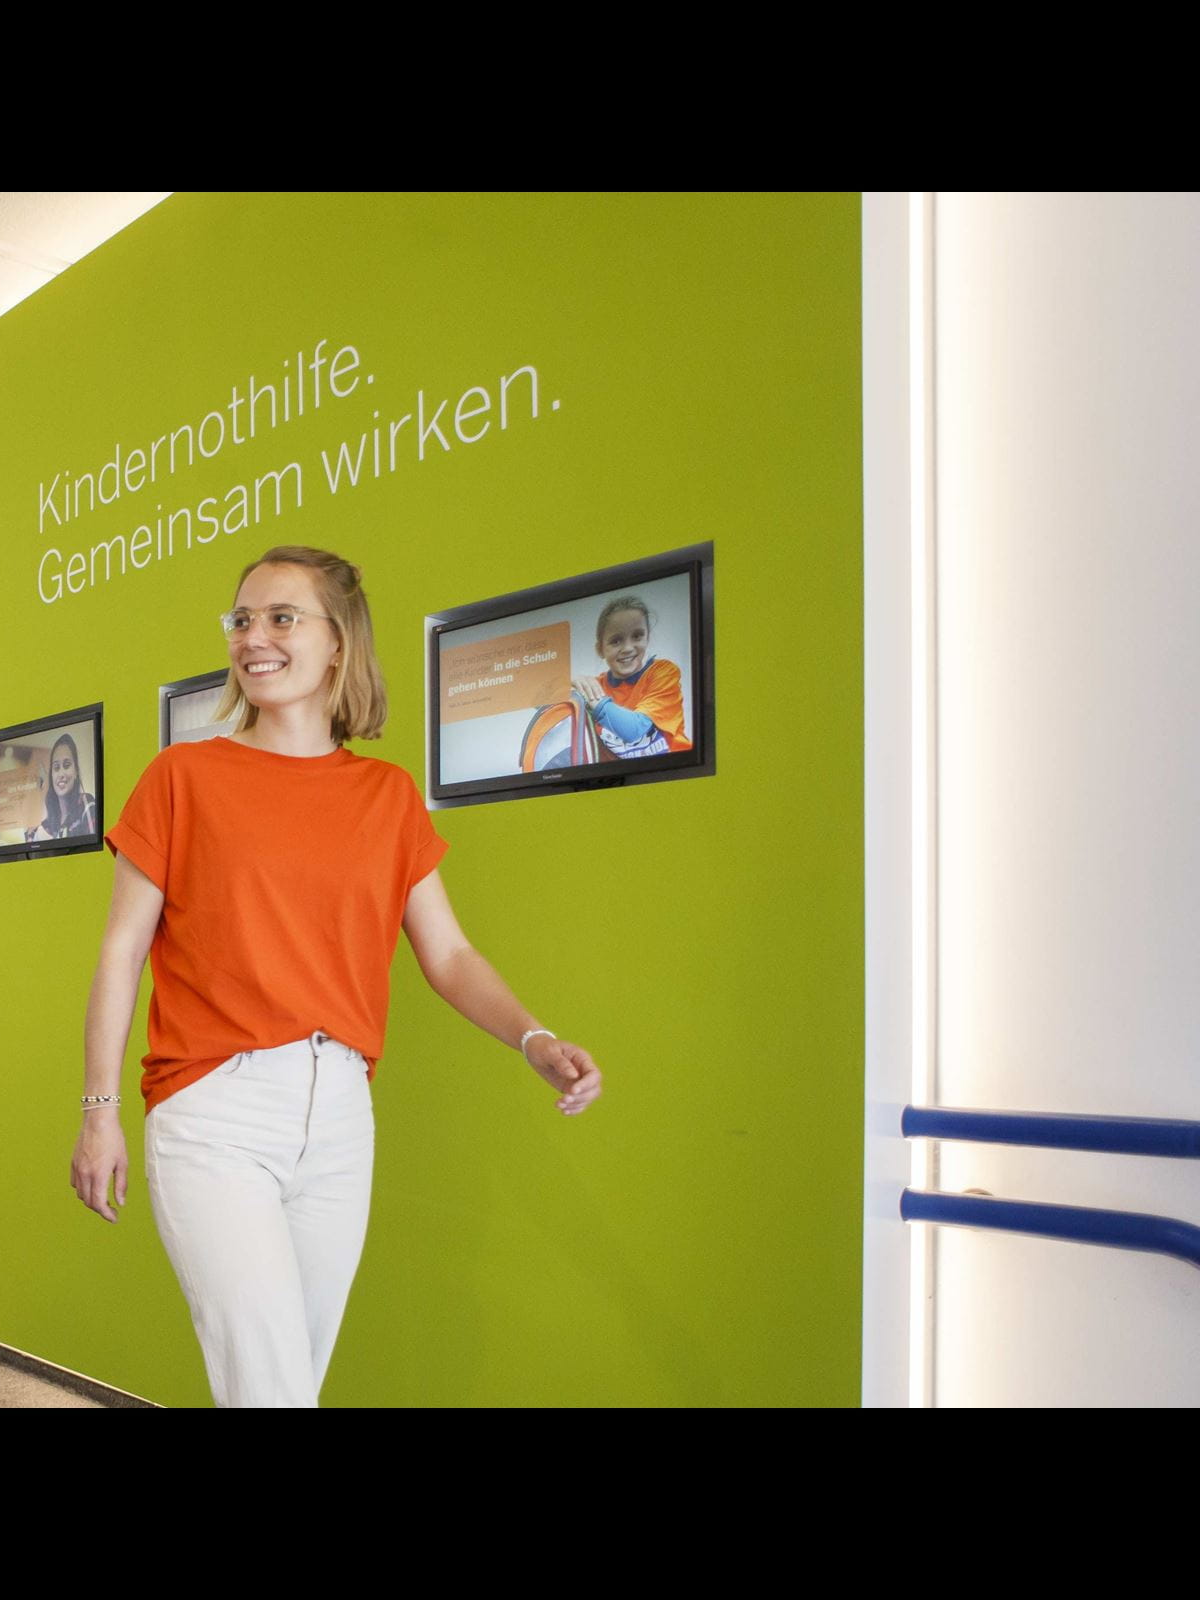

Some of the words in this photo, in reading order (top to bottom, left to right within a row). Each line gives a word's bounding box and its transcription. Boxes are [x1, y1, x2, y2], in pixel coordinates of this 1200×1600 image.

[37, 462, 302, 604] Gemeinsam
[320, 364, 562, 494] wirken.
[38, 339, 375, 534] Kindernothilfe.
[448, 681, 476, 696] gehen
[478, 674, 513, 688] können
[494, 662, 503, 671] in
[505, 657, 521, 670] die
[523, 650, 557, 666] Schule
